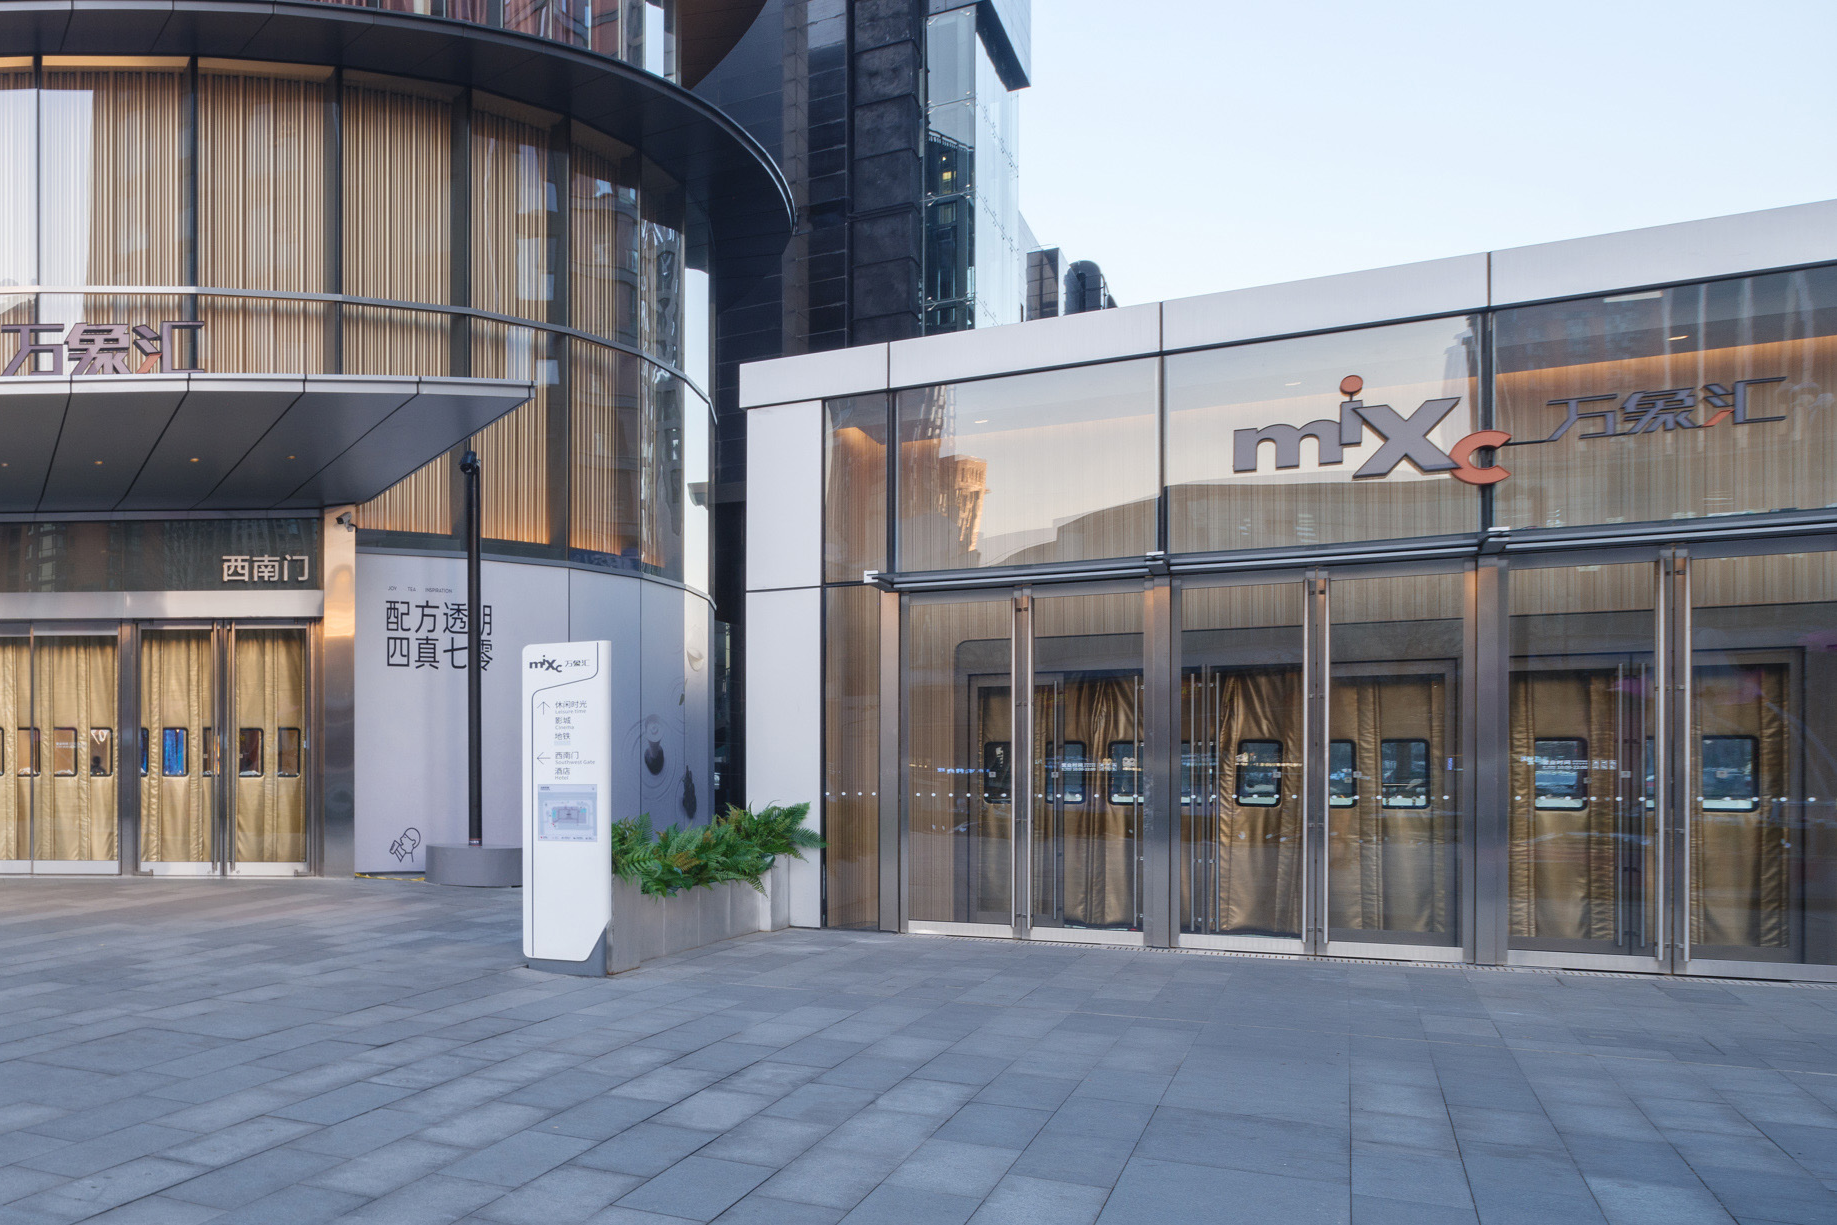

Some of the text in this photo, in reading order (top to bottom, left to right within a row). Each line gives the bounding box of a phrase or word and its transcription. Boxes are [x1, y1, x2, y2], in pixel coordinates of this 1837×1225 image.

[0, 320, 205, 376] 万象汇
[1546, 376, 1787, 442] 万象汇
[222, 554, 309, 582] 西南门
[565, 659, 591, 668] 万象汇
[555, 700, 587, 709] 休闲时光
[555, 716, 571, 725] 影城
[555, 732, 571, 741] 地铁
[555, 751, 579, 760] 西南门
[555, 767, 571, 776] 酒店
